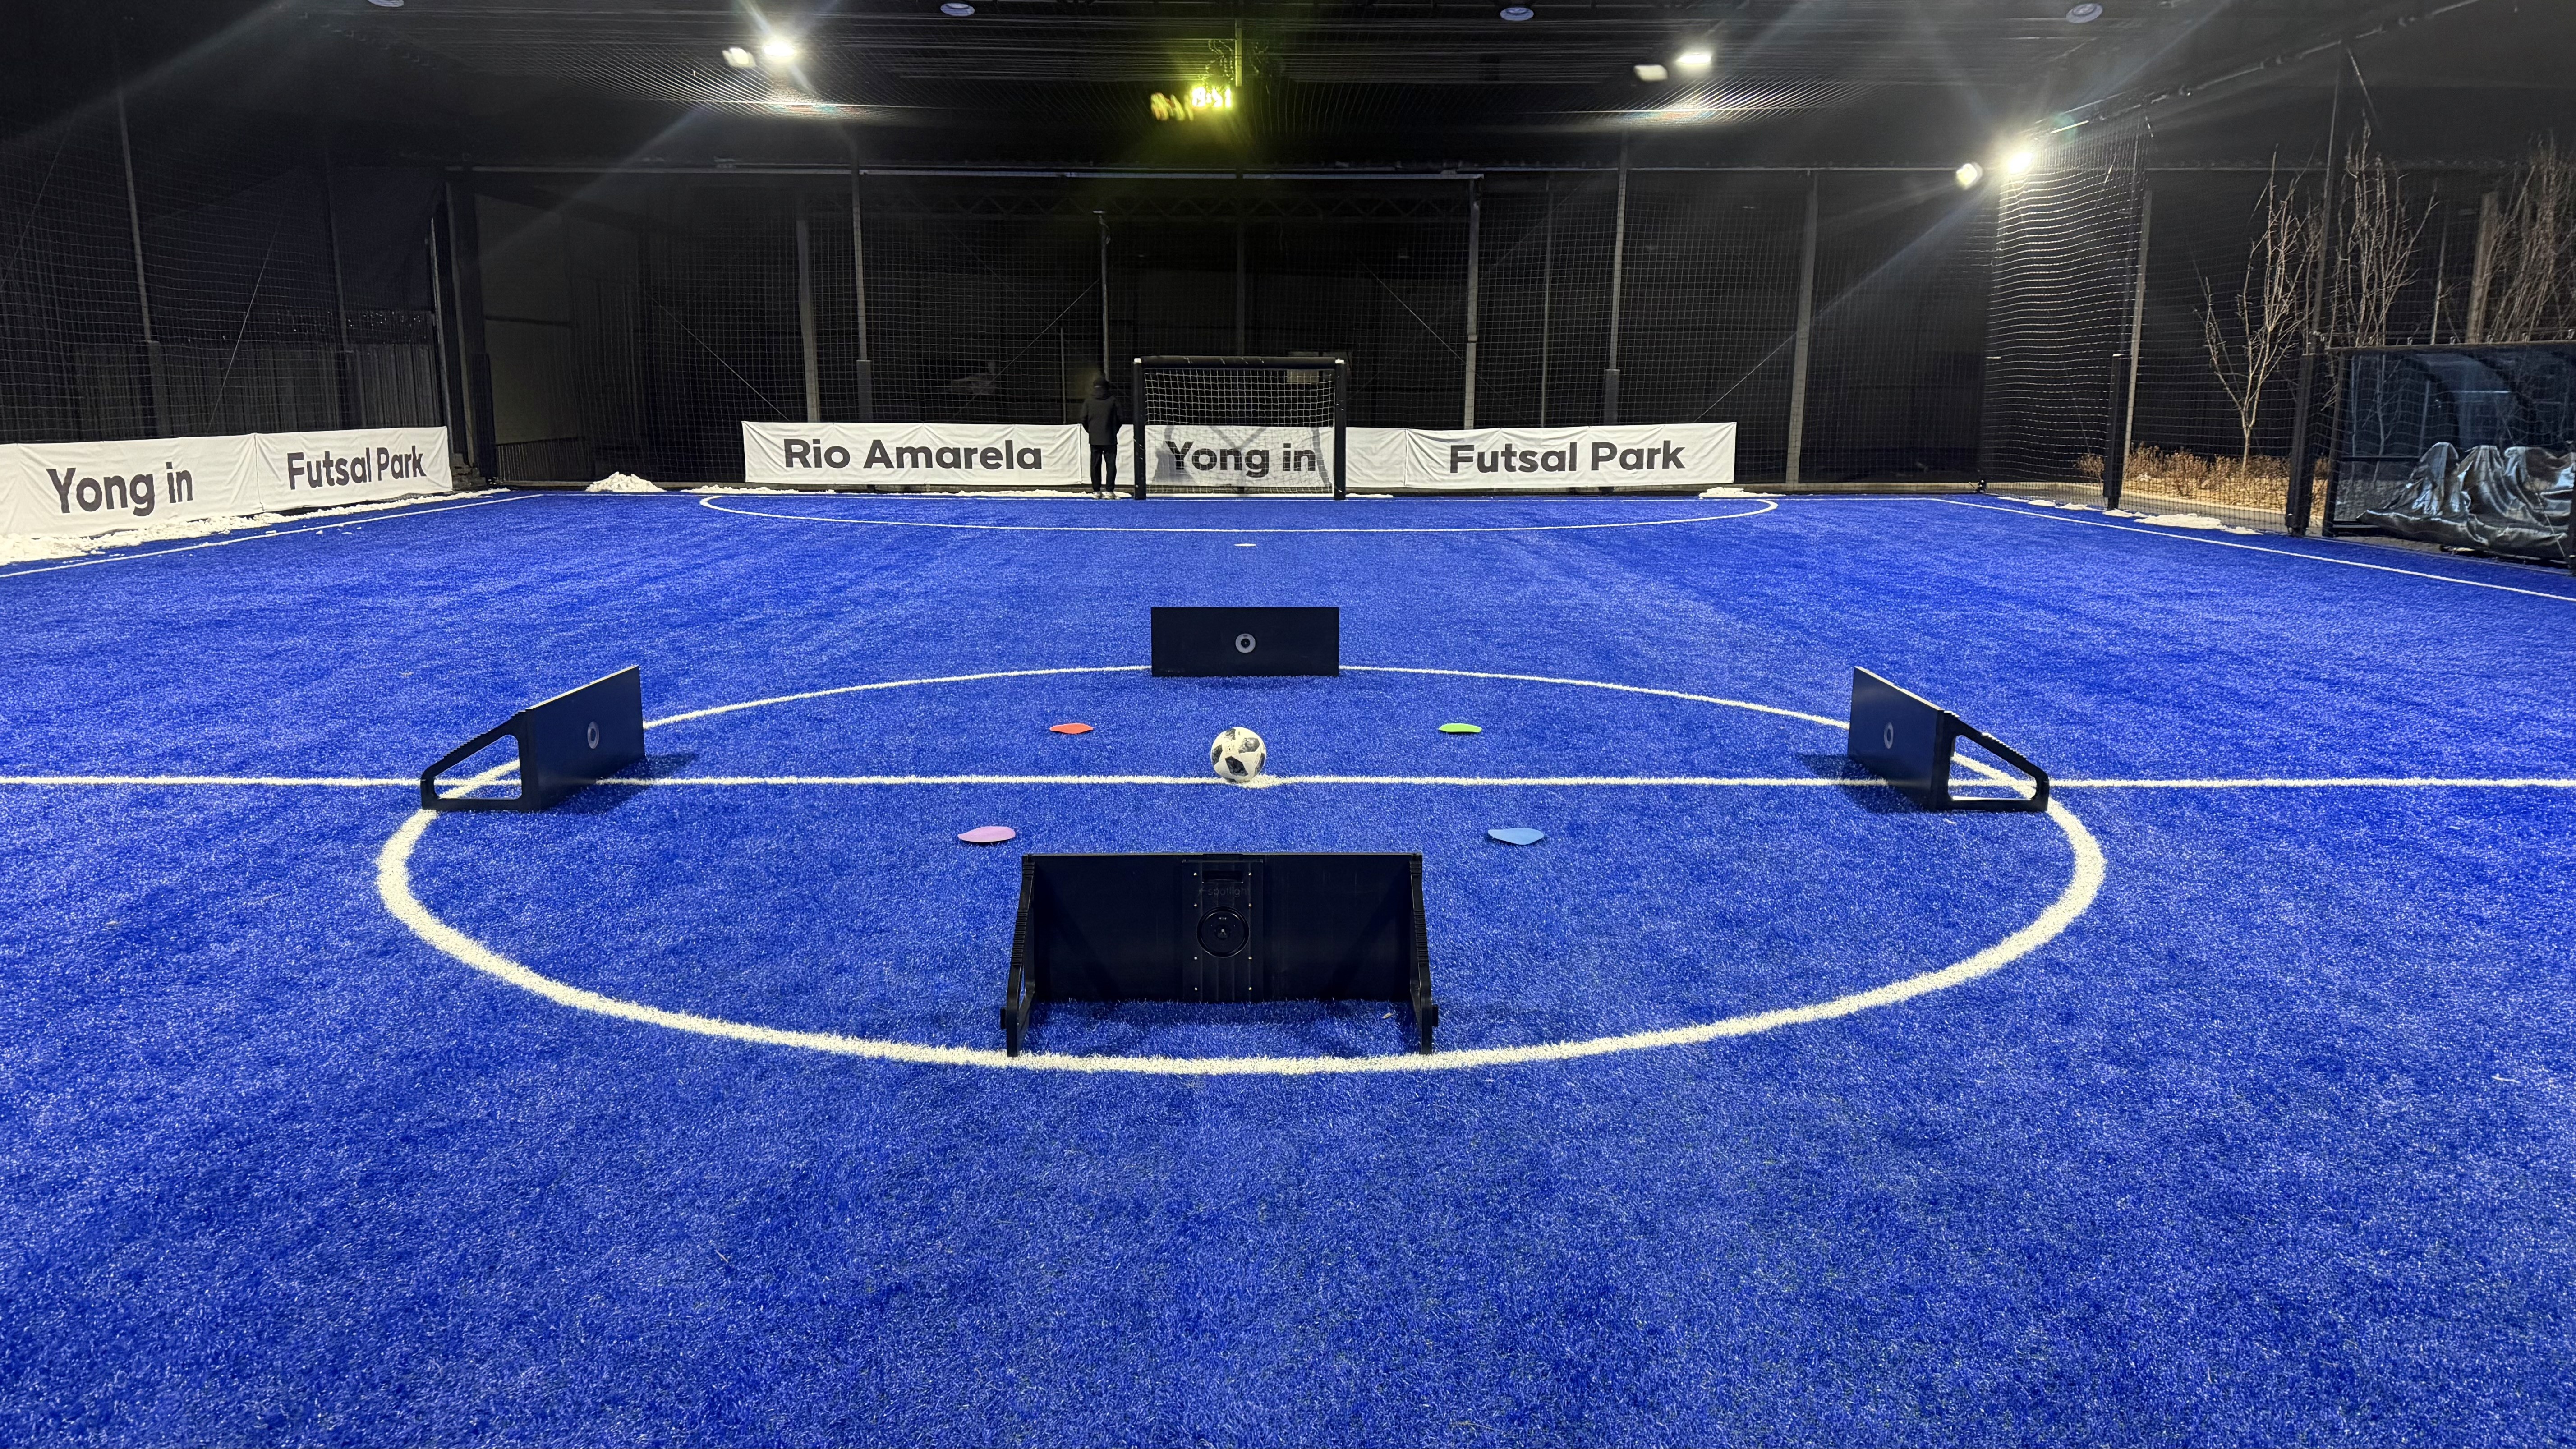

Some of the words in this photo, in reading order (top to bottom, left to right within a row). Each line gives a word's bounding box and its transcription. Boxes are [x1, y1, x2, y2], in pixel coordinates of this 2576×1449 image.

[287, 447, 371, 490] Futsal
[377, 446, 427, 481] Park
[784, 439, 850, 468] Rio
[863, 440, 1042, 469] Amarela
[1166, 441, 1269, 478] Yong
[1283, 443, 1316, 471] in
[1449, 442, 1577, 473] Futsal
[1591, 440, 1685, 470] Park
[46, 468, 155, 516] Yong
[166, 462, 193, 503] in
